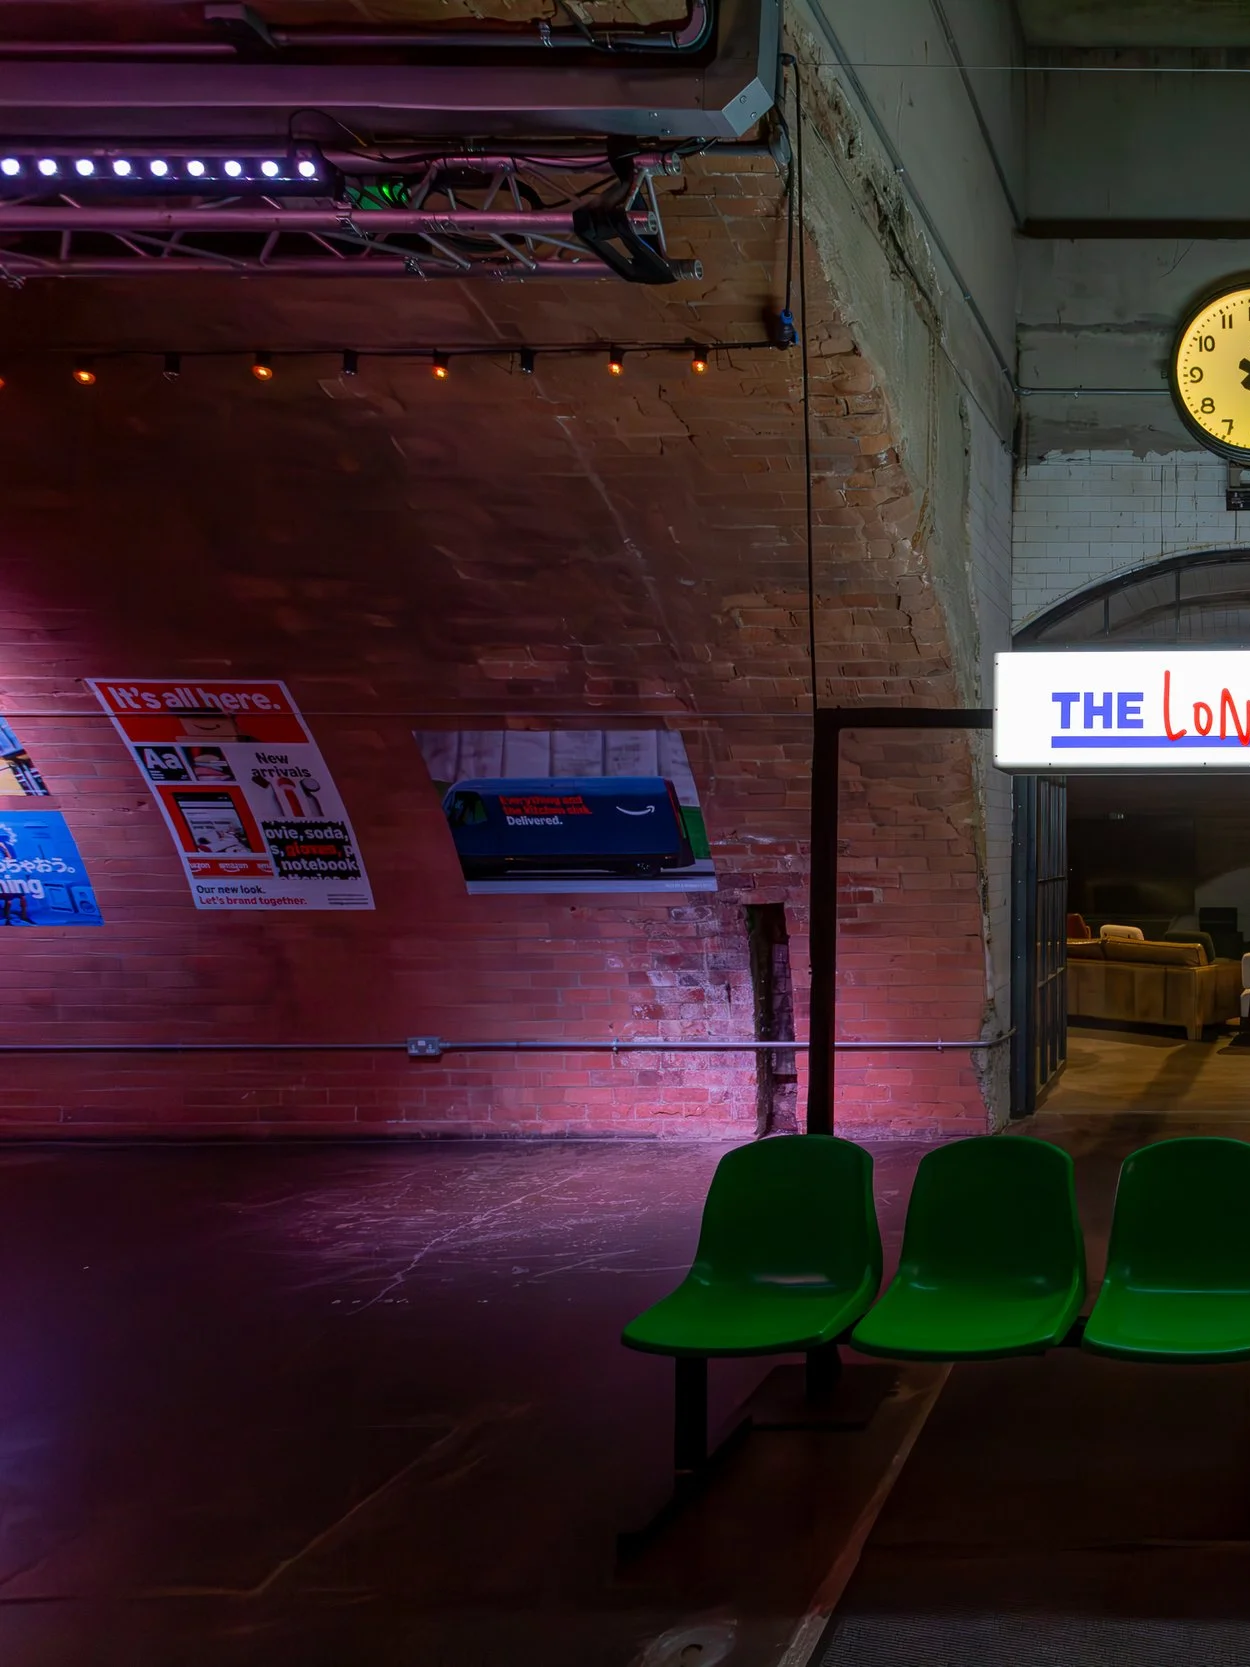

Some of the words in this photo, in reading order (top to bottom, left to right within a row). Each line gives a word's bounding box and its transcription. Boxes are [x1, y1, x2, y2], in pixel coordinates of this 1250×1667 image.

[1222, 313, 1233, 329] 11
[1199, 335, 1215, 352] 10
[1189, 366, 1204, 383] 9
[1200, 397, 1216, 413] 8
[1221, 419, 1234, 435] 7
[107, 686, 161, 710] It's
[161, 687, 200, 708] all
[196, 687, 281, 710] here.
[1051, 691, 1144, 729] THE
[143, 748, 184, 770] Aa
[255, 752, 289, 764] New
[251, 766, 311, 778] arrivals
[506, 815, 563, 826] Delivered.
[304, 826, 348, 842] soda,
[196, 885, 214, 894] Our
[218, 886, 238, 894] new
[240, 885, 266, 894] look.
[199, 896, 225, 905] Let's
[226, 896, 257, 905] brand
[258, 896, 307, 907] together.
